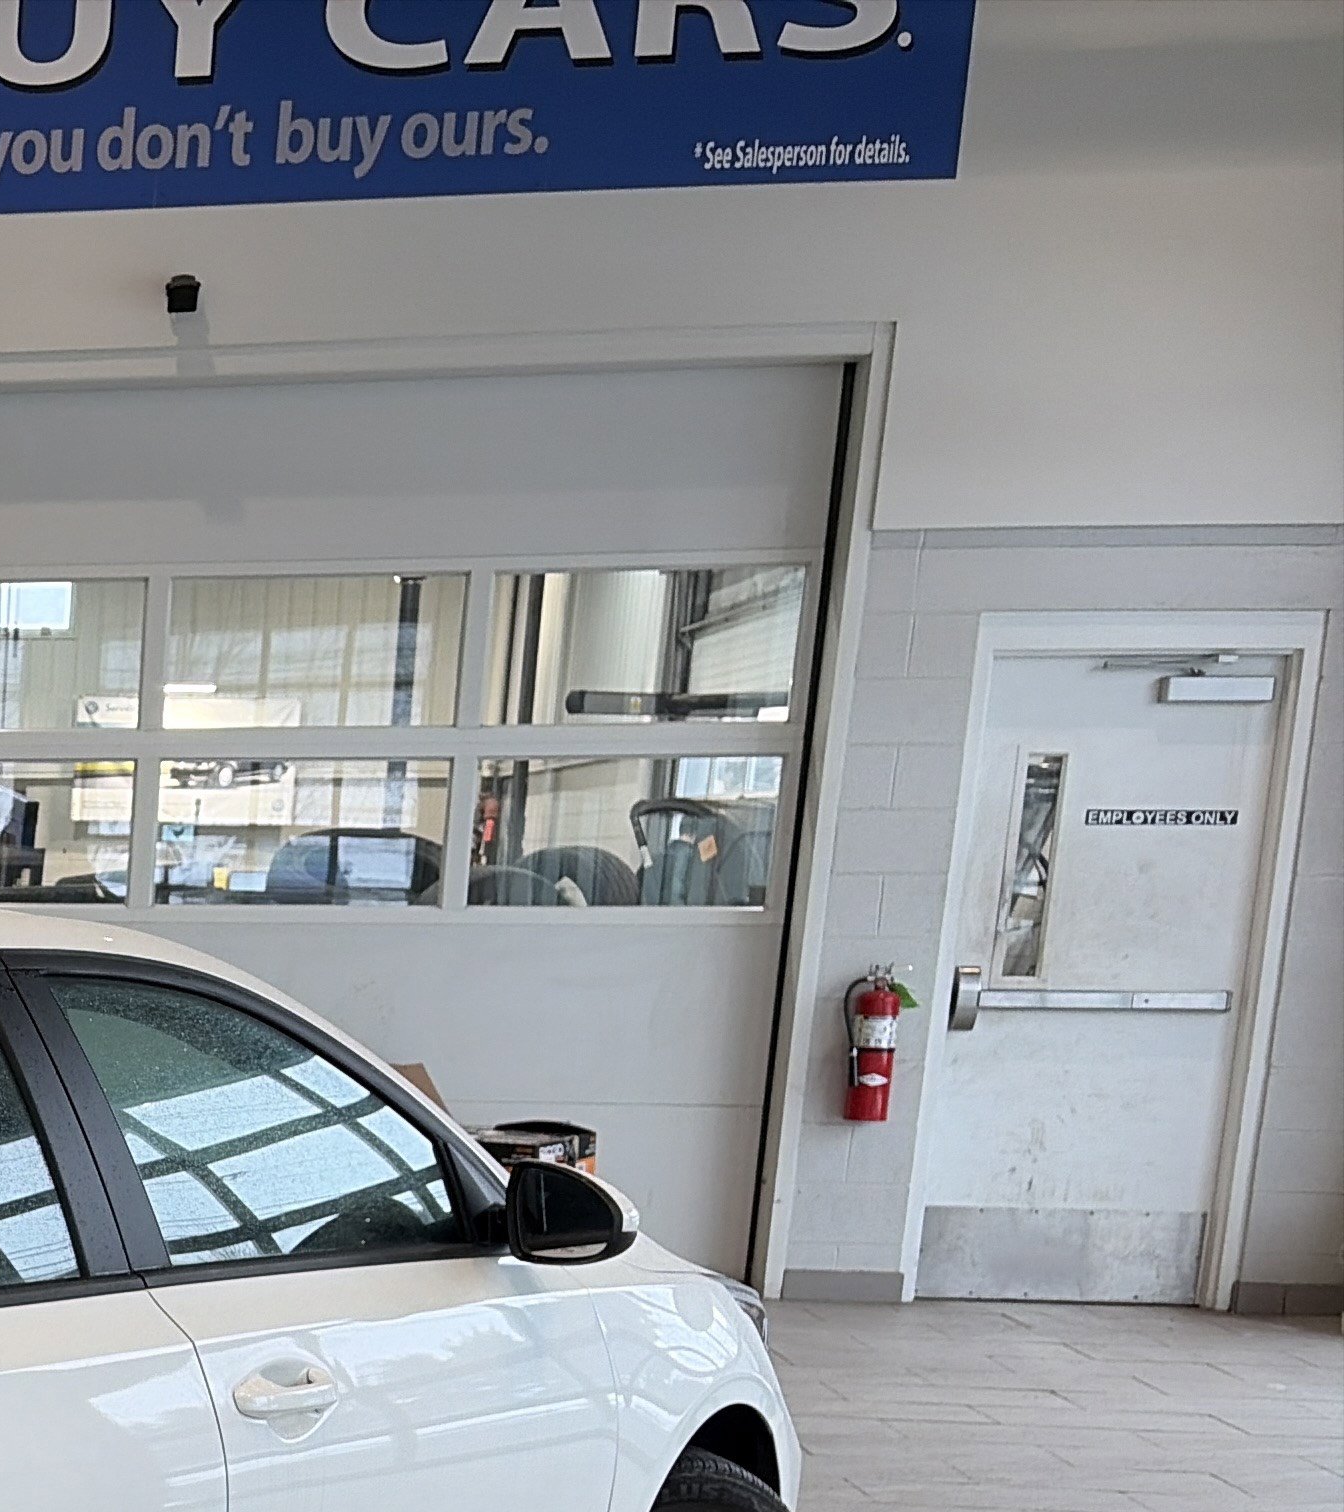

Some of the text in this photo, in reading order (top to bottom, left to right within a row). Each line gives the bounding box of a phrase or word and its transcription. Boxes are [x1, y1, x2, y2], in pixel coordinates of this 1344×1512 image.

[96, 105, 254, 171] don't
[275, 99, 393, 179] buy
[401, 107, 550, 160] ours.
[734, 138, 826, 174] Salesperson
[829, 135, 852, 167] for
[854, 134, 910, 165] details.
[1088, 810, 1236, 825] EMPLOYEES ONLY
